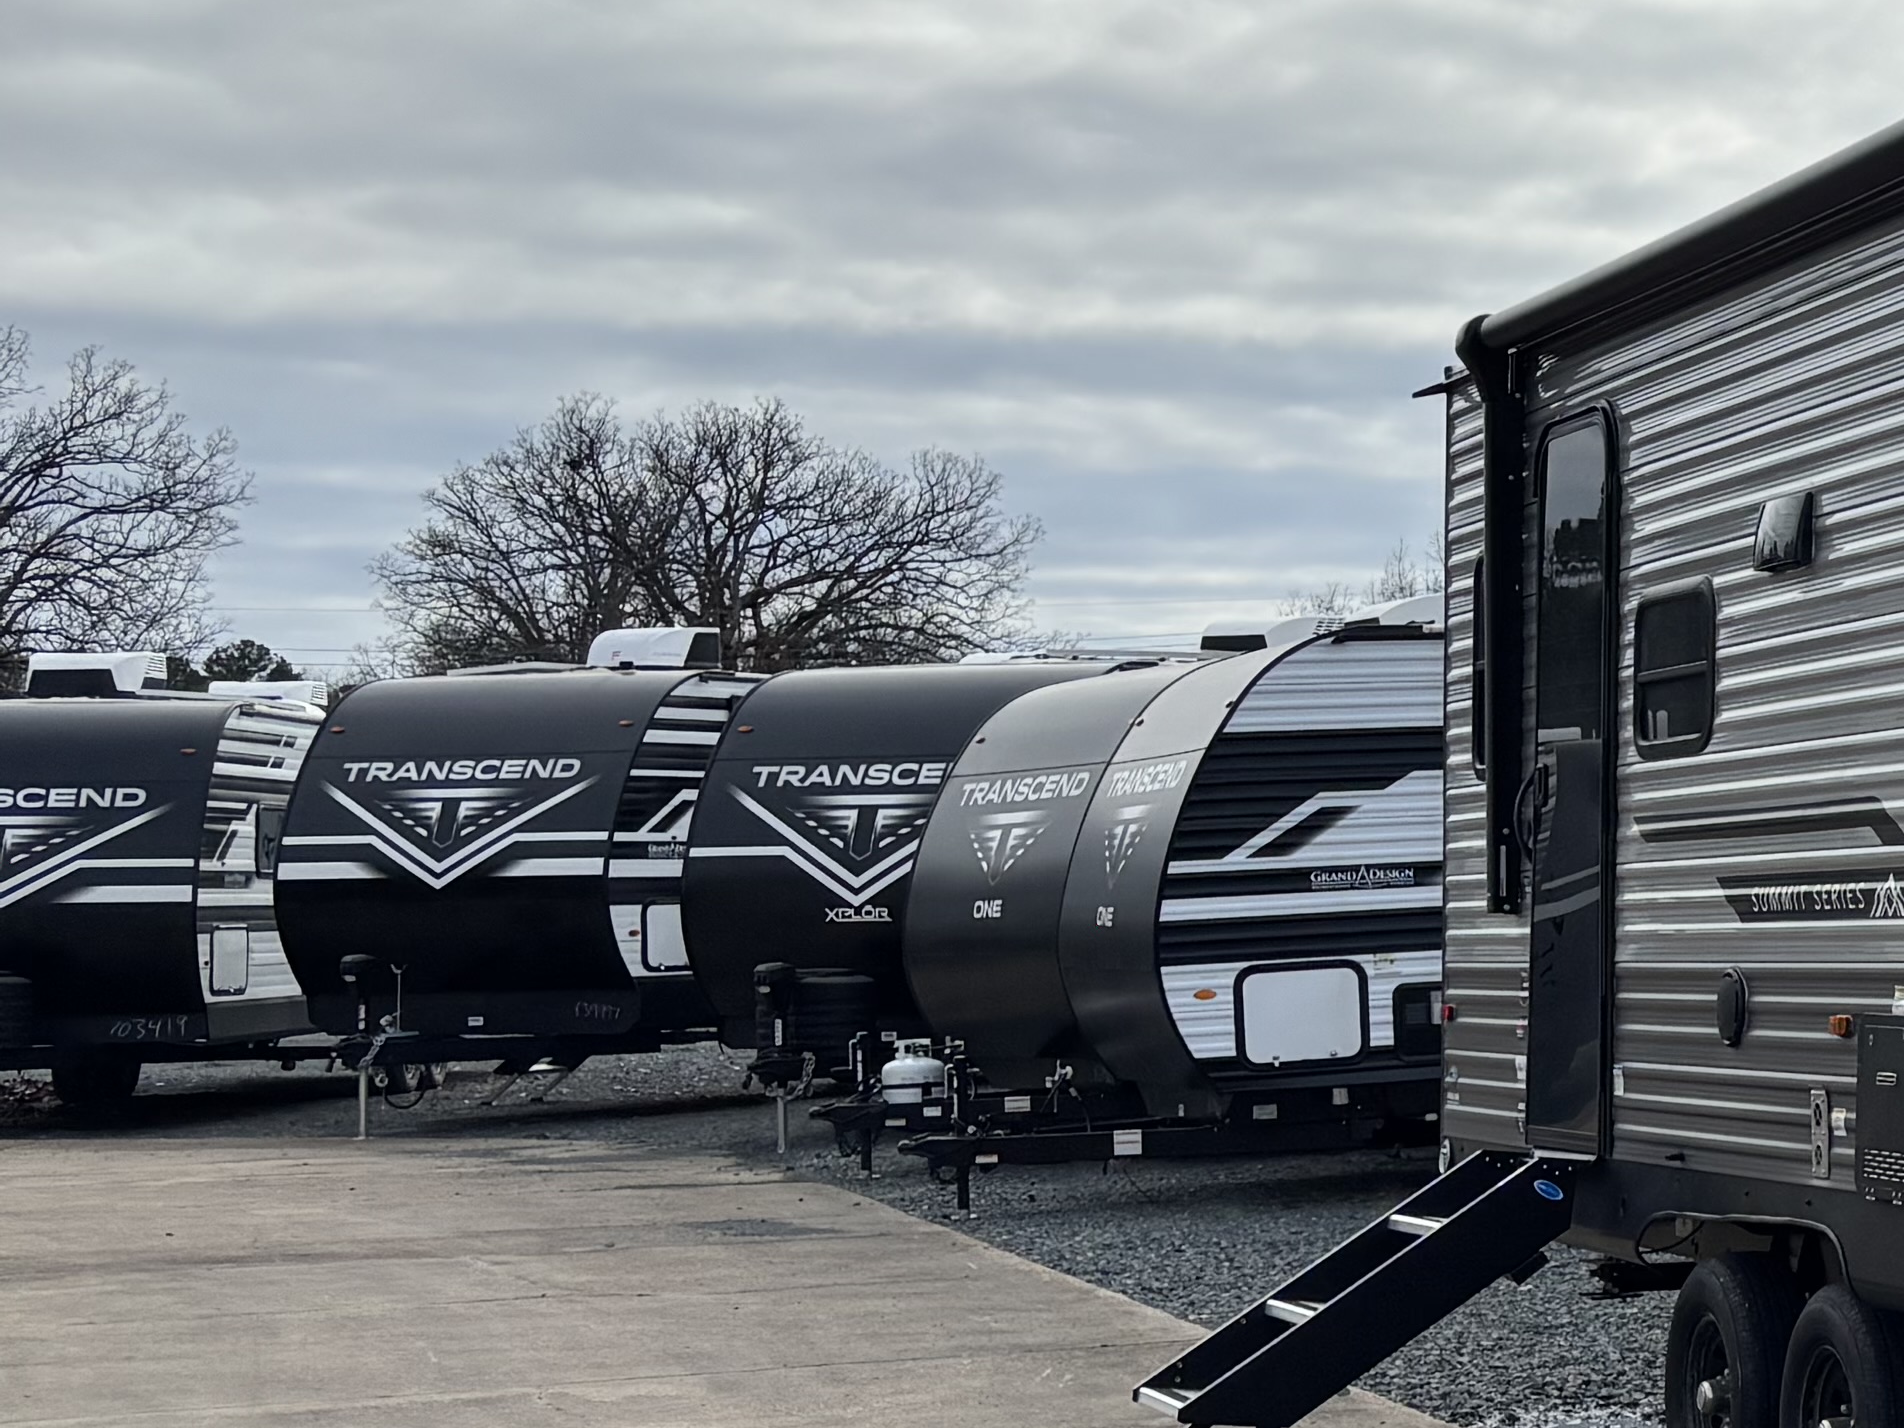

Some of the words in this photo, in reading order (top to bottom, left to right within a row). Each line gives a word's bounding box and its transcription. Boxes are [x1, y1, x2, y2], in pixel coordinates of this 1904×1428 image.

[343, 758, 582, 782] TRANSCEND
[752, 762, 953, 788] TRANSCE
[1106, 760, 1188, 797] TRANSCEND
[959, 771, 1091, 807] TRANSCEND
[1310, 870, 1356, 883] GRAND
[1369, 868, 1414, 880] DESIGN
[973, 899, 1003, 919] ONE
[1751, 884, 1808, 912] SUMMIT
[1813, 881, 1865, 910] SERIES
[1096, 905, 1115, 928] ONE
[110, 1014, 188, 1039] 103419
